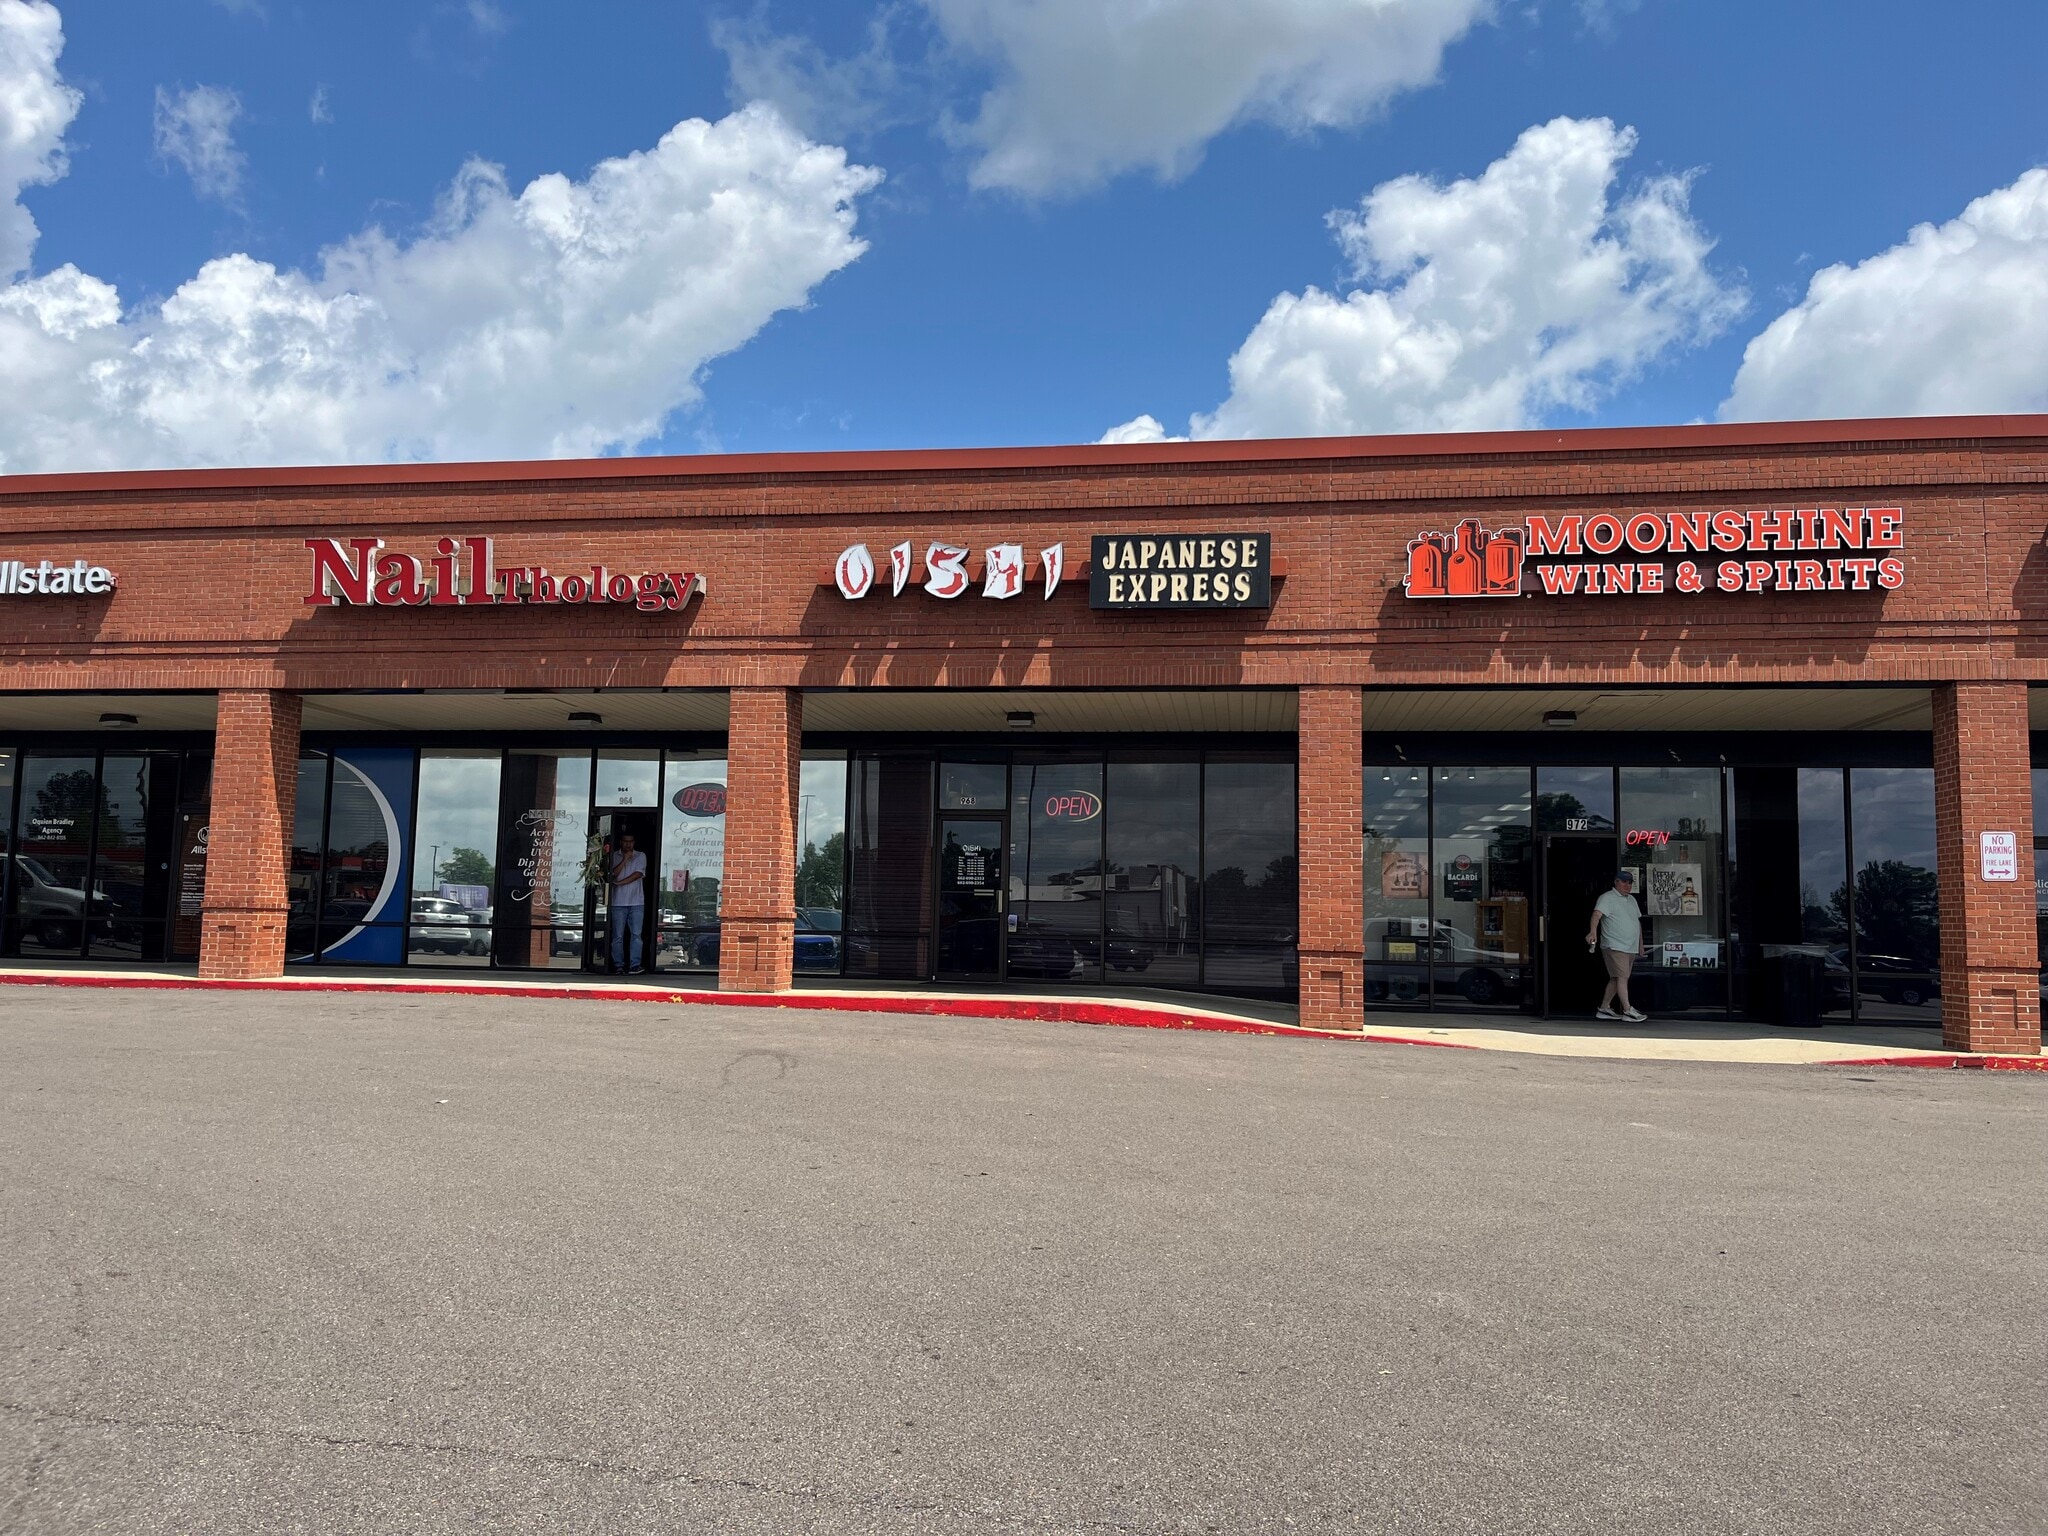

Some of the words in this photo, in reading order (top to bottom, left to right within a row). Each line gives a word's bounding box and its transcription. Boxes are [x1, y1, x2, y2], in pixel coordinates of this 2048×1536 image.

[1525, 507, 1904, 556] MOONSHINE
[1102, 538, 1259, 570] JAPANESE
[0, 560, 111, 594] llstate
[303, 537, 498, 606] Nail
[496, 566, 701, 612] Thology
[1537, 563, 1664, 595] WINE
[1674, 561, 1707, 594] &
[1717, 557, 1905, 593] SPIRITS
[1108, 572, 1252, 603] EXPRESS
[619, 797, 633, 805] 964
[680, 788, 727, 812] OPEN
[960, 797, 976, 805] 968
[1046, 796, 1092, 817] OPEN
[53, 818, 75, 827] Bradley
[1567, 819, 1587, 830] 972
[41, 827, 63, 835] Agency
[529, 828, 563, 838] Acrylic
[533, 838, 559, 847] Solar
[1626, 829, 1670, 846] OPEN
[1992, 836, 2004, 845] NO
[530, 848, 561, 857] UV-Gel
[1984, 846, 2013, 855] PARKING
[517, 858, 535, 868] Dip
[688, 859, 723, 868] Shellac
[523, 868, 538, 877] Gel
[1447, 872, 1478, 881] BACARDÍ
[528, 878, 560, 887] Omb
[1670, 957, 1716, 968] FRM
